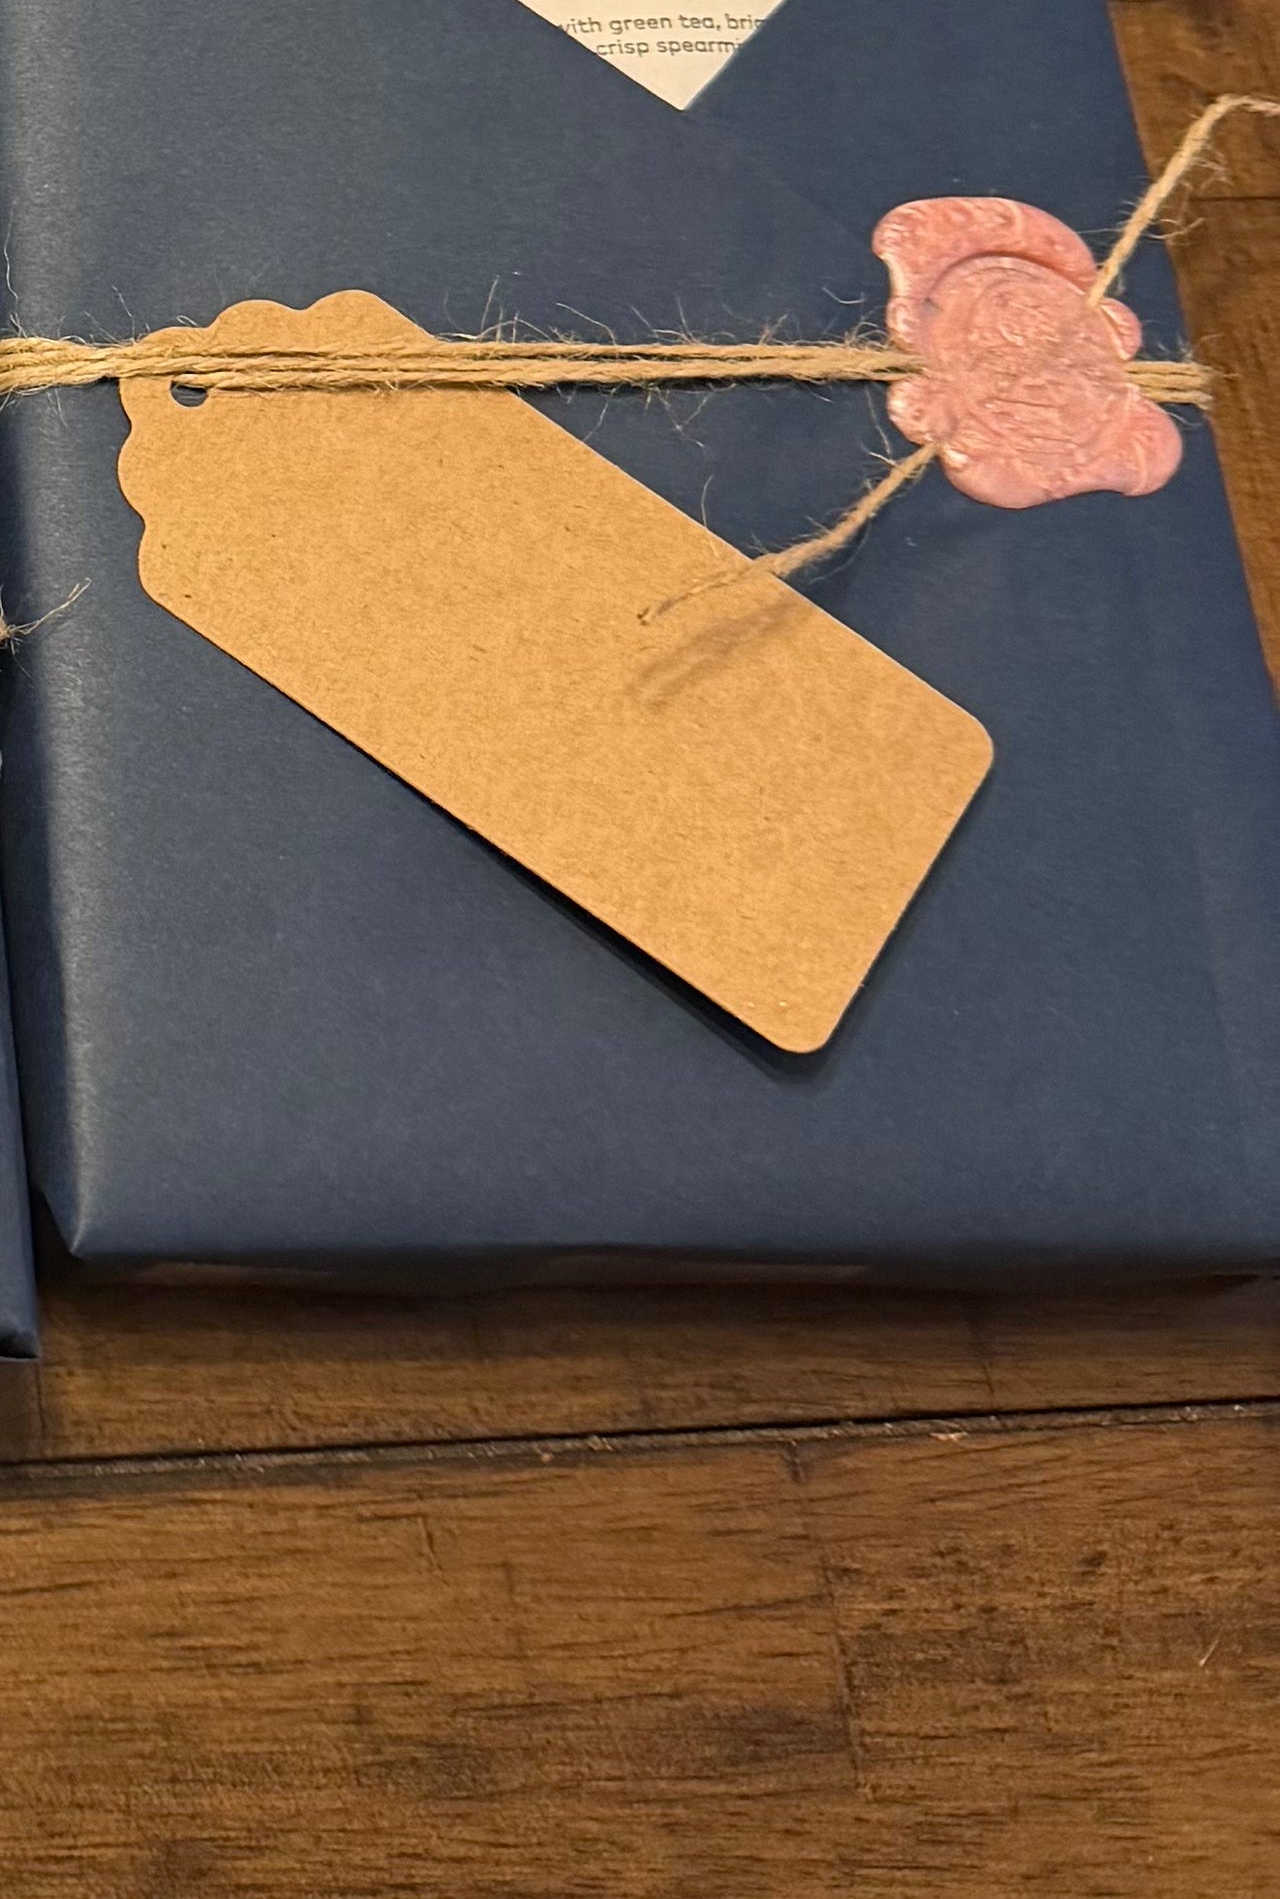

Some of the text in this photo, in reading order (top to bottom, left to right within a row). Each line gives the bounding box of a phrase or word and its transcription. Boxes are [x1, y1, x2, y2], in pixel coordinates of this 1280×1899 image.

[610, 16, 672, 35] green
[678, 13, 721, 31] tea,
[596, 38, 649, 57] crisp
